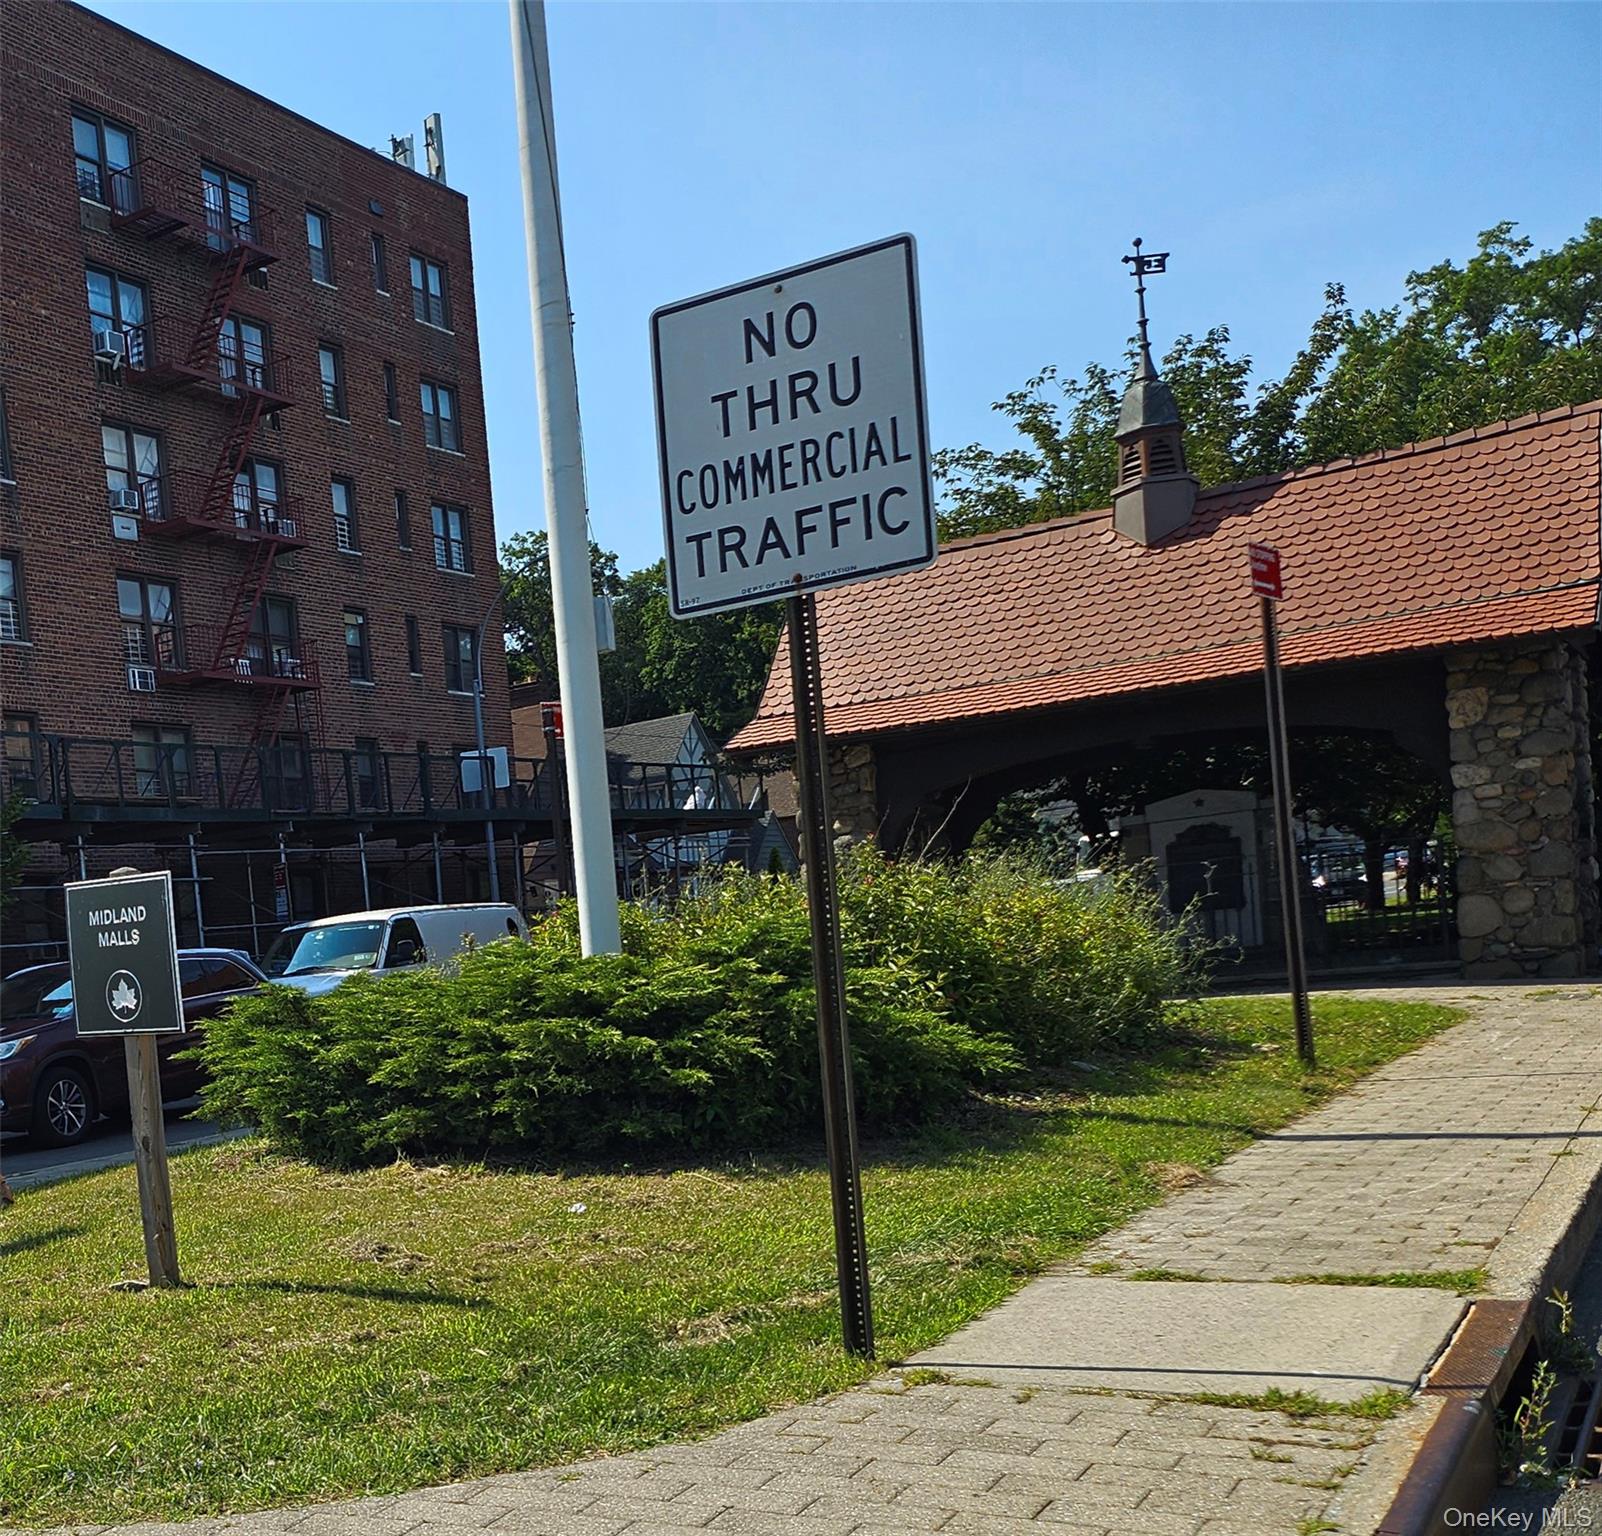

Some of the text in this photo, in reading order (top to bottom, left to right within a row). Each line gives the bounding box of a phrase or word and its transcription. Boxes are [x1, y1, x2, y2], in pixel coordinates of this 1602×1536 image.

[743, 301, 817, 364] NO
[711, 355, 862, 438] THRU
[676, 416, 912, 515] COMMERCIAL
[686, 486, 910, 577] TRAFFIC
[741, 565, 857, 594] DEPT OF TRASPORTATION
[88, 905, 147, 926] MIDLAND
[98, 928, 141, 948] MALLS
